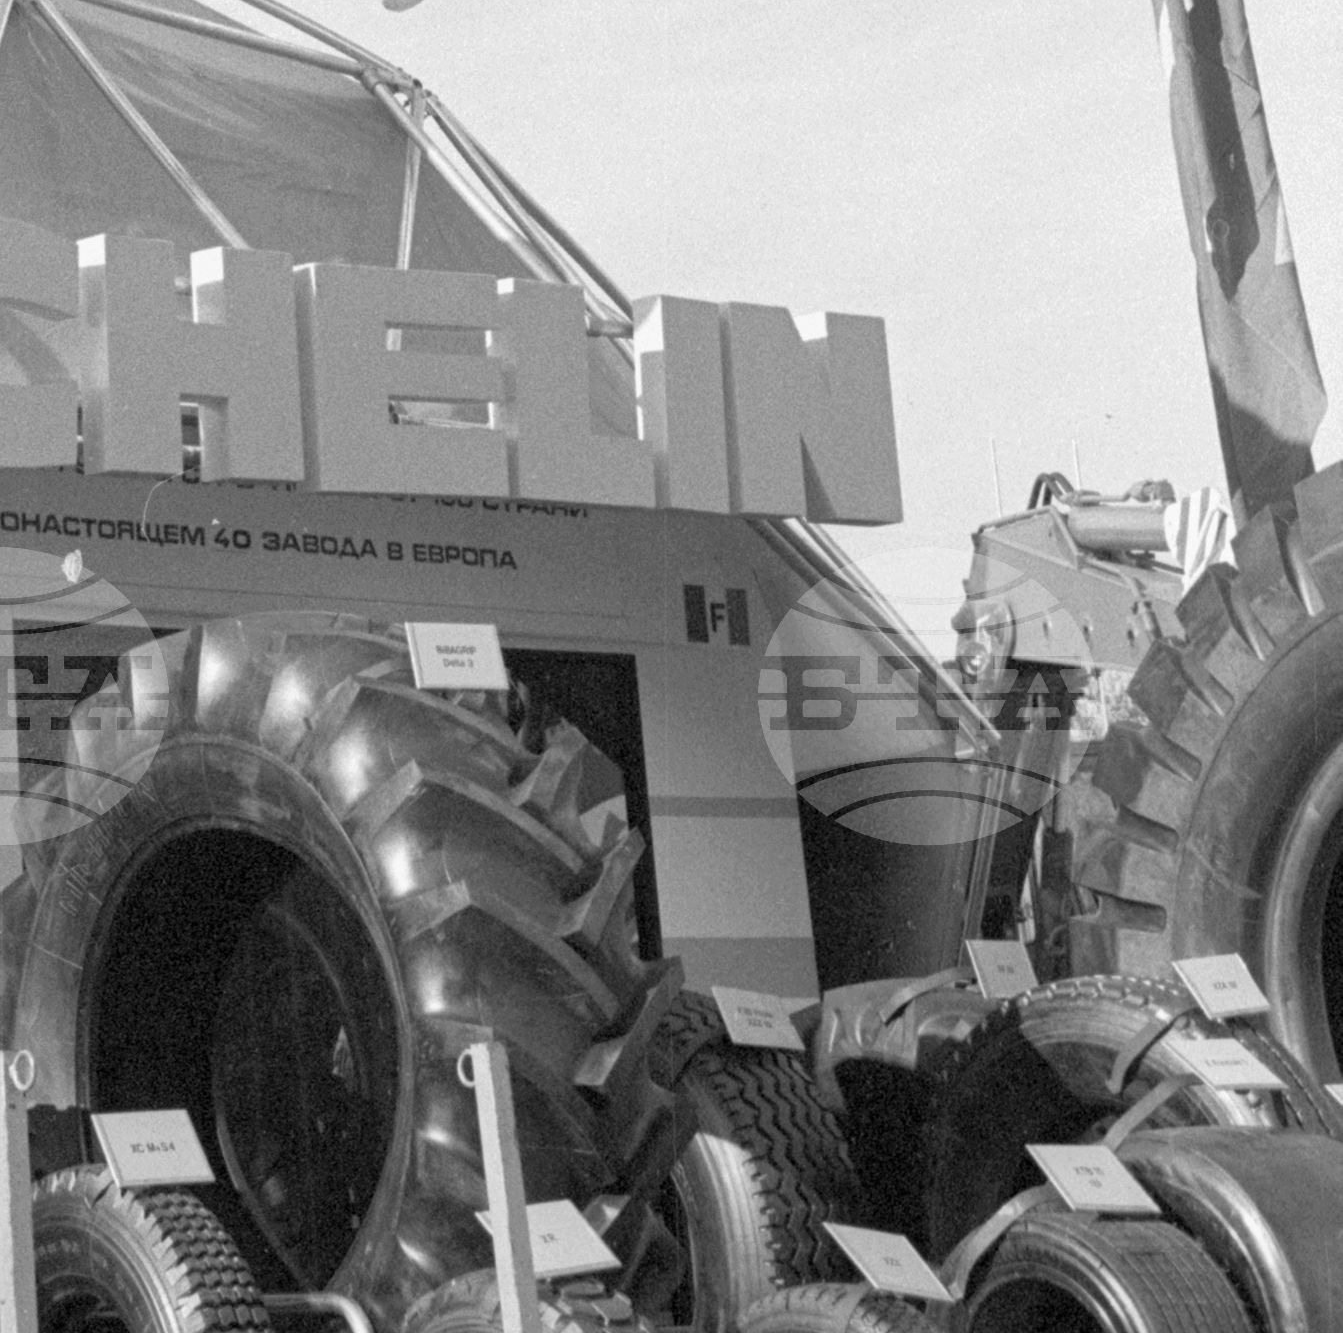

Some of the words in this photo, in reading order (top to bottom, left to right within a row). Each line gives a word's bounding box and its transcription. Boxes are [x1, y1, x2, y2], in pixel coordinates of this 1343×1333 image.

[214, 526, 252, 550] 40
[263, 531, 378, 559] ЗАВОДА
[388, 541, 404, 561] В
[413, 543, 518, 570] ЕВРОПА
